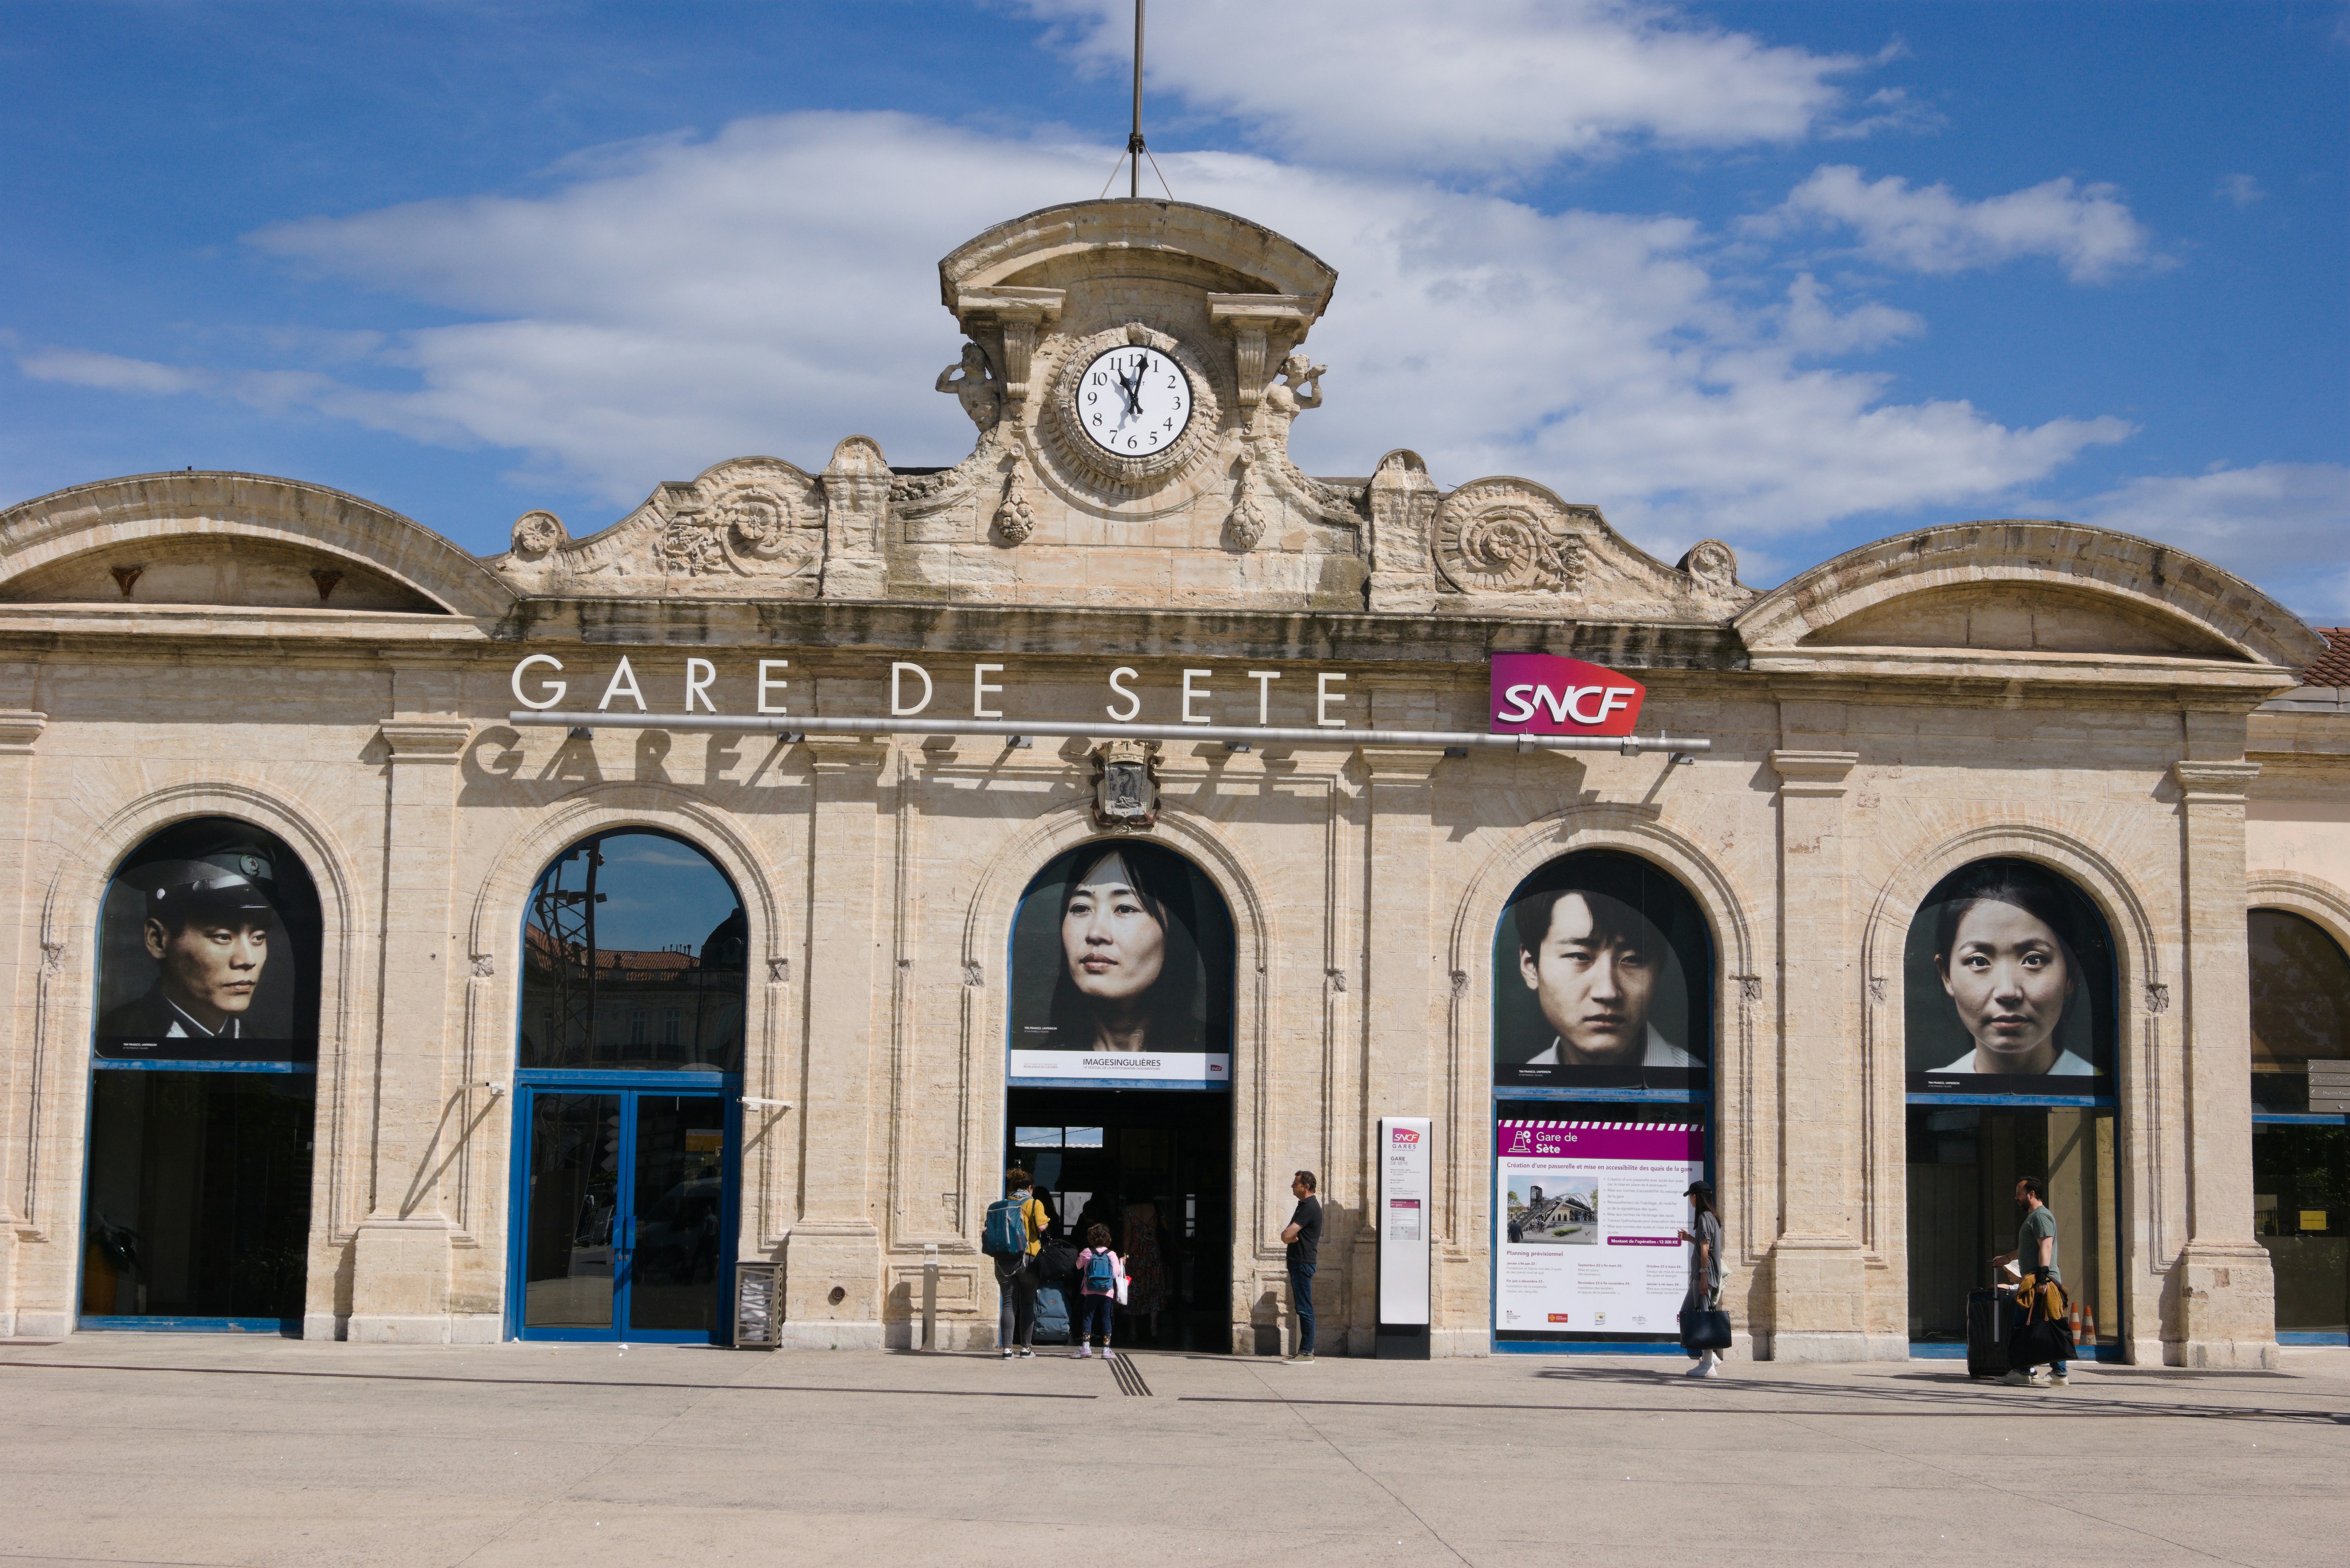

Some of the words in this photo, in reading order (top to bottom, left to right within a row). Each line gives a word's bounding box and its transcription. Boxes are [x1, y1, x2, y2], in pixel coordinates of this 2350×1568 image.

[1109, 357, 1123, 370] 11
[1153, 360, 1159, 372] 1
[1092, 372, 1107, 386] 10
[1167, 375, 1176, 388] 2
[1088, 392, 1097, 405] 9
[1172, 397, 1181, 410] 3
[1092, 413, 1102, 426] 8
[1163, 417, 1173, 431] 4
[1109, 430, 1117, 444] 7
[1128, 435, 1137, 448] 6
[1148, 431, 1157, 445] 5
[512, 654, 788, 713] GARE
[891, 662, 1003, 717] DE
[1106, 666, 1346, 726] SETE
[1497, 684, 1635, 723] SNCF
[1536, 1132, 1561, 1141] Gare
[1564, 1132, 1577, 1142] de
[1536, 1144, 1560, 1153] Sète
